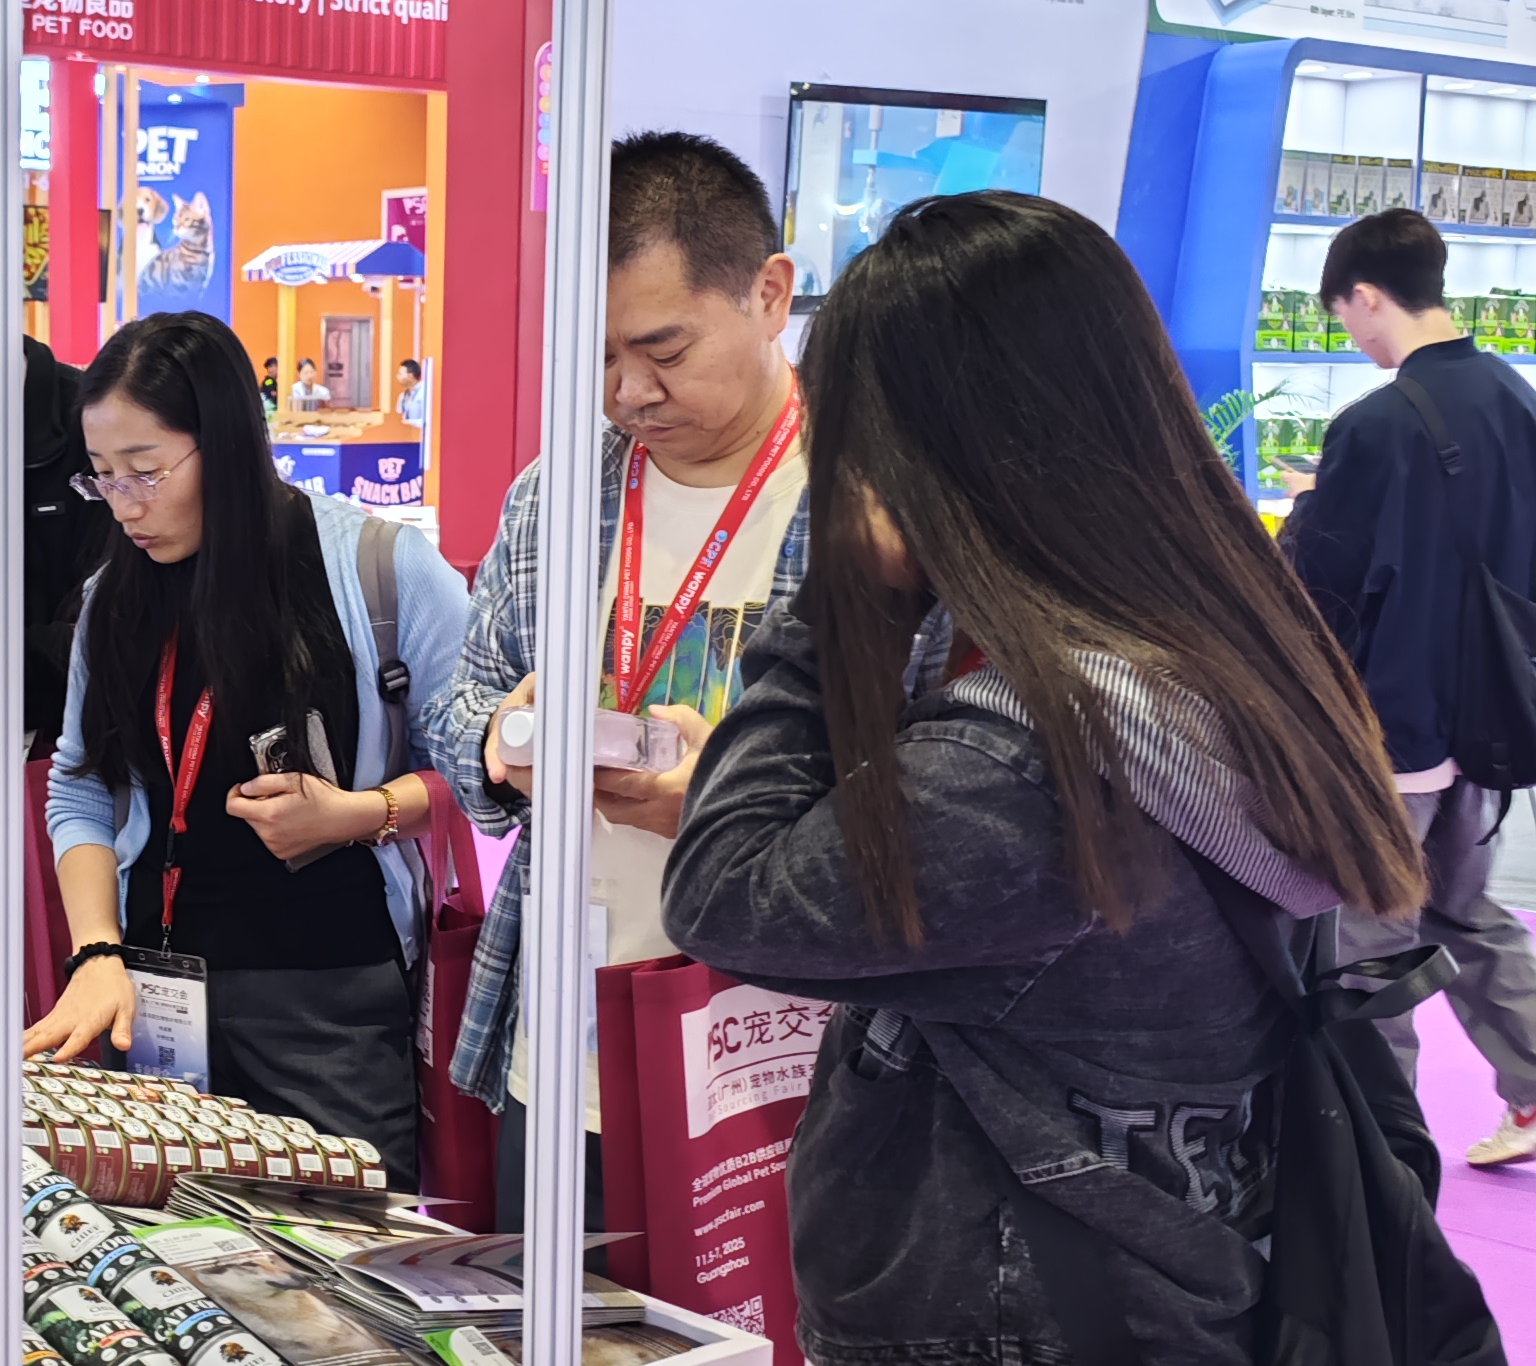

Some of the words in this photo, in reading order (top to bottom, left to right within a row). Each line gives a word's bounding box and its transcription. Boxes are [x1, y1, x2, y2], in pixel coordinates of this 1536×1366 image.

[32, 15, 71, 34] PET
[79, 18, 134, 41] FOOD
[351, 475, 401, 505] SNACK
[674, 571, 706, 615] wanpy
[621, 629, 634, 674] wanpy
